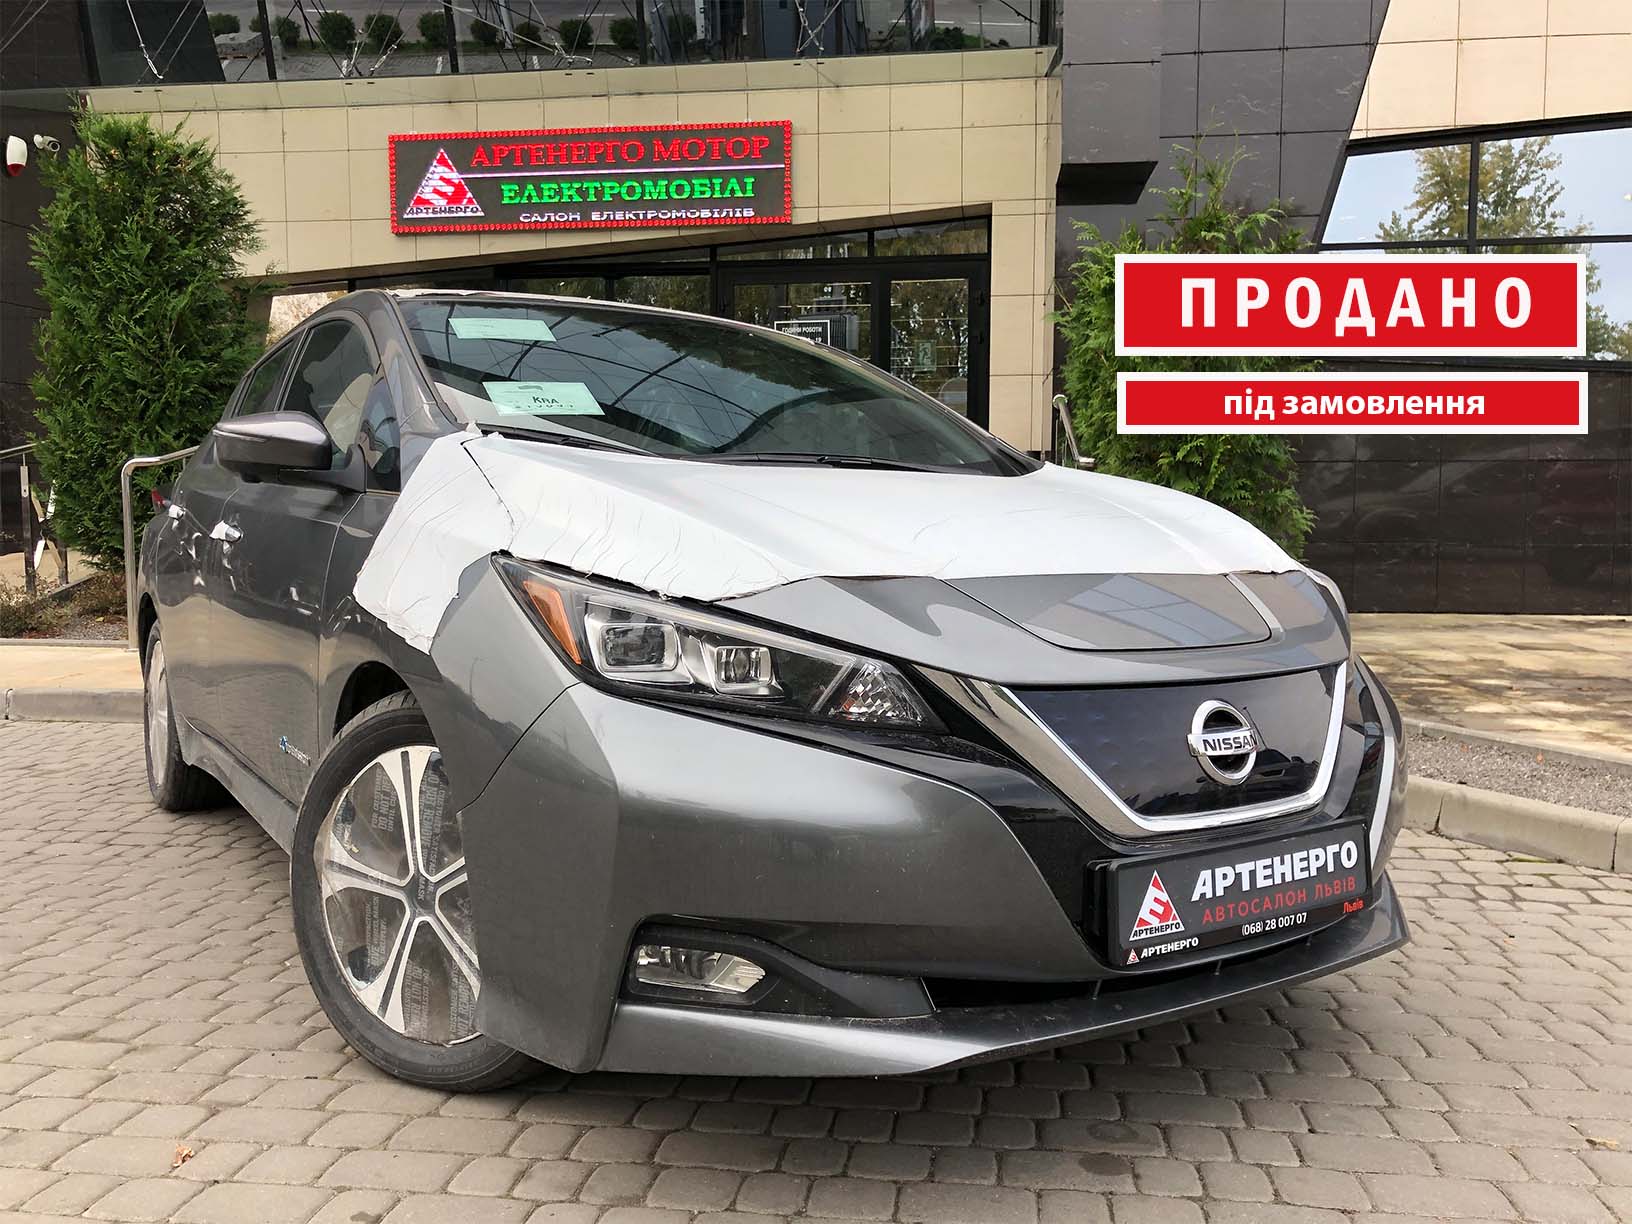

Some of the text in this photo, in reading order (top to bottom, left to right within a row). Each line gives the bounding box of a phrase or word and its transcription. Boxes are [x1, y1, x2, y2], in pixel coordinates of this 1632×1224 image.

[471, 136, 771, 167] АРТЕНЕРГО МОТОР
[501, 176, 755, 205] ЕЛЕКТРОМОБІЛІ
[406, 205, 480, 216] АРТЕНЕРГО
[519, 208, 755, 223] САЛОН ЕЛЕКТРОМОБІЛІВ
[1202, 734, 1258, 752] NISSAN
[1190, 840, 1359, 902] АРТЕНЕРГО
[1202, 875, 1356, 925] АВТОСАЛОН ЛЬВІВ
[1343, 898, 1365, 914] Львів
[1132, 921, 1181, 939] АРТЕНЕРГО
[1241, 912, 1307, 937] (068) 28 007 07
[1140, 936, 1199, 958] АРТЕНЕРГО
